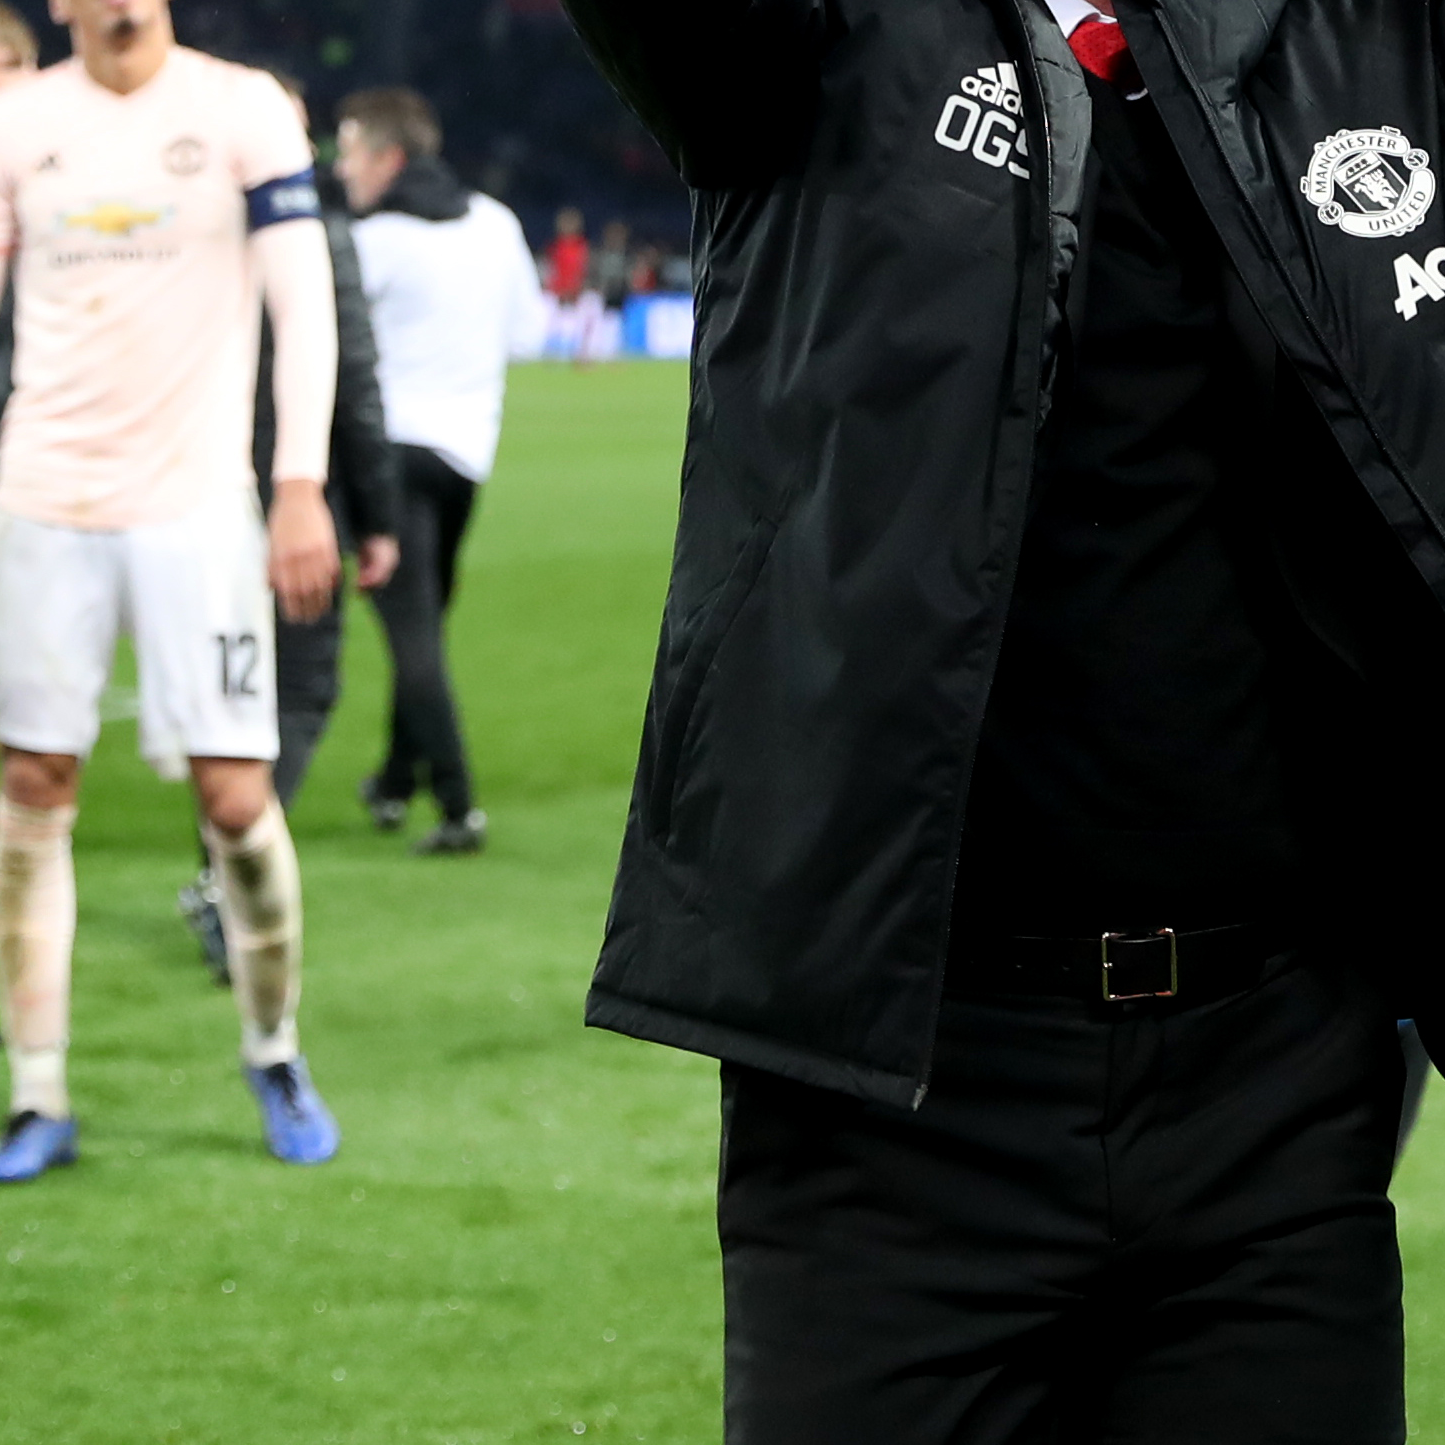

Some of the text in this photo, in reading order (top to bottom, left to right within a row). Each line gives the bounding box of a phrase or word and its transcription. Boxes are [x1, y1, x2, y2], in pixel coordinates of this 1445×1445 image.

[960, 75, 1024, 117] adid
[1315, 135, 1398, 193] MANCHESTER
[1369, 190, 1426, 231] UNITED
[214, 633, 259, 696] 12
